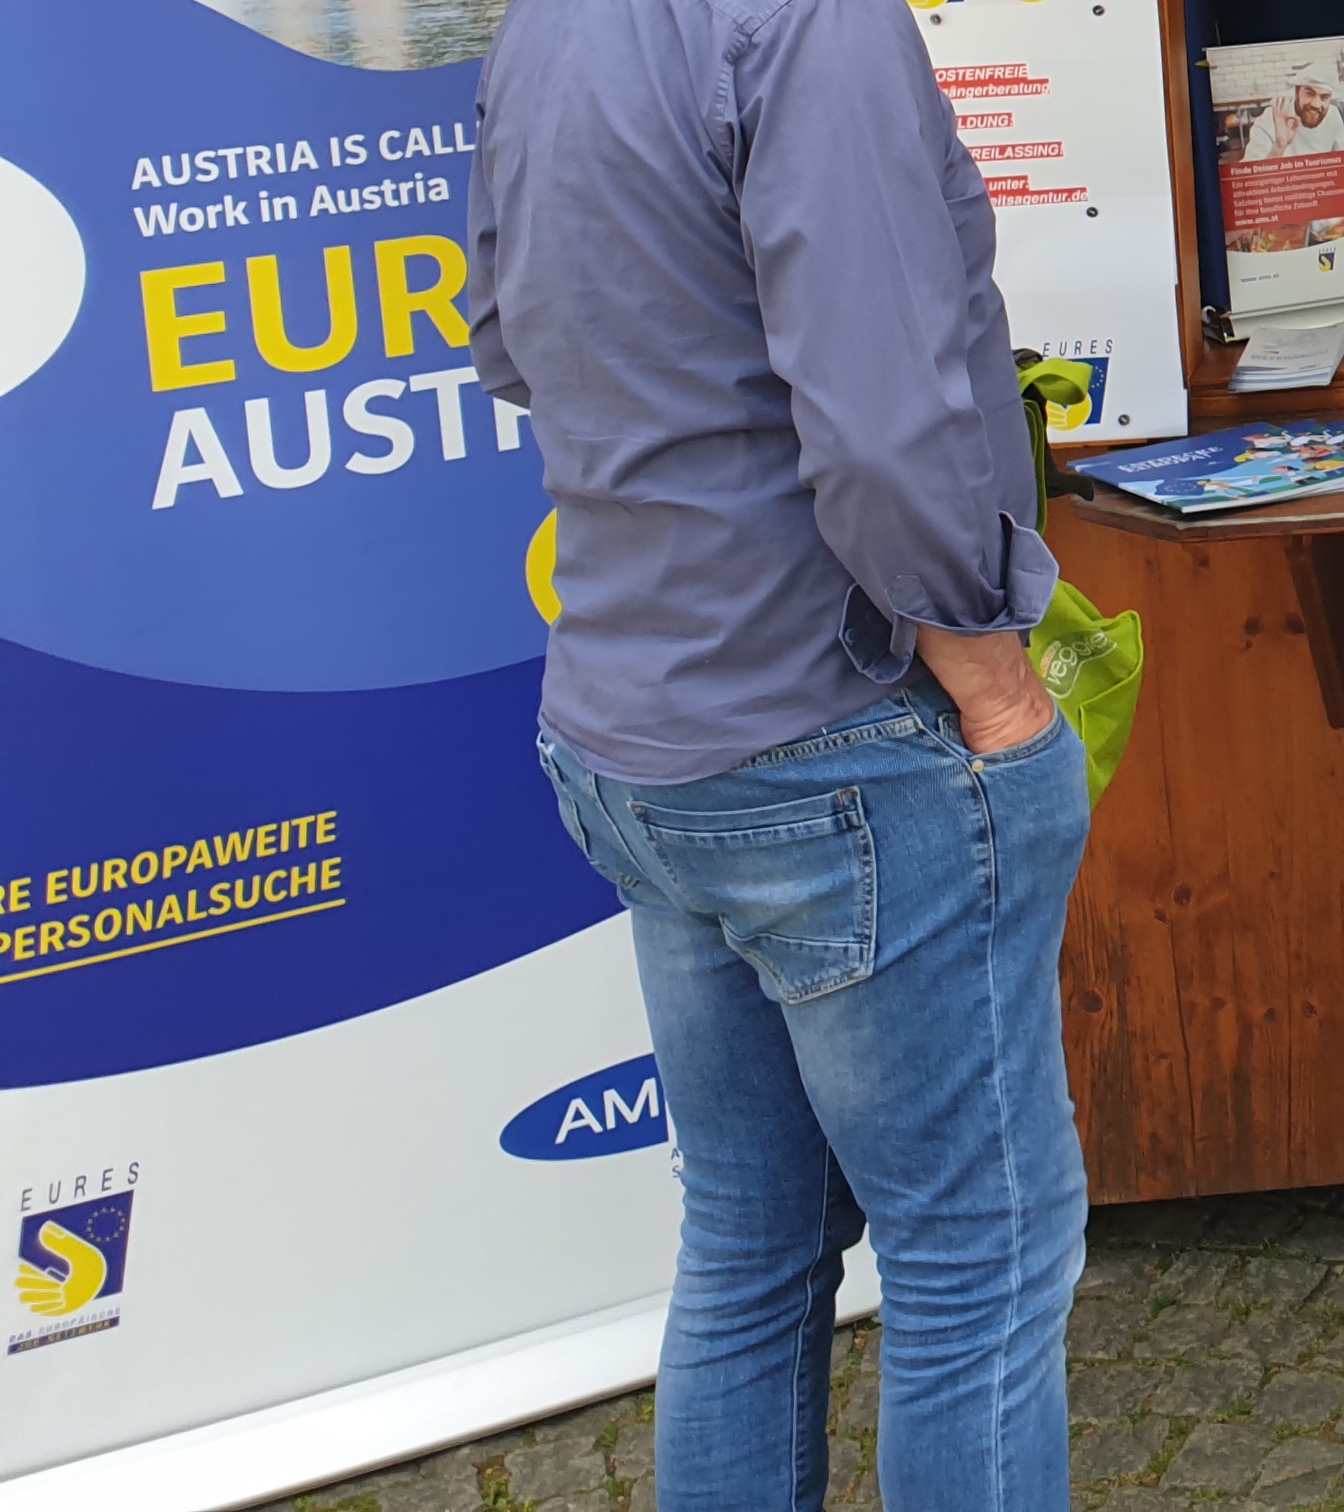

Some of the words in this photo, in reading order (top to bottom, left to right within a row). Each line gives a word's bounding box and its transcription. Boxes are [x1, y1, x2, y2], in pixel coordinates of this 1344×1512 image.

[935, 66, 1028, 82] OSTENFREIE
[957, 115, 1014, 129] LDUNG:
[131, 141, 319, 190] AUSTRIA
[330, 134, 367, 169] IS
[379, 121, 480, 160] CALL
[969, 144, 1064, 159] REILASSING!
[134, 195, 249, 236] Work
[260, 189, 298, 223] in
[310, 173, 450, 218] Austria
[991, 190, 1088, 206] eitsagentur.de
[140, 235, 471, 392] EUR
[1041, 339, 1114, 358] EURES
[46, 810, 338, 906] EUROPAWEITE
[555, 1077, 660, 1146] AM
[19, 1161, 140, 1212] EURES
